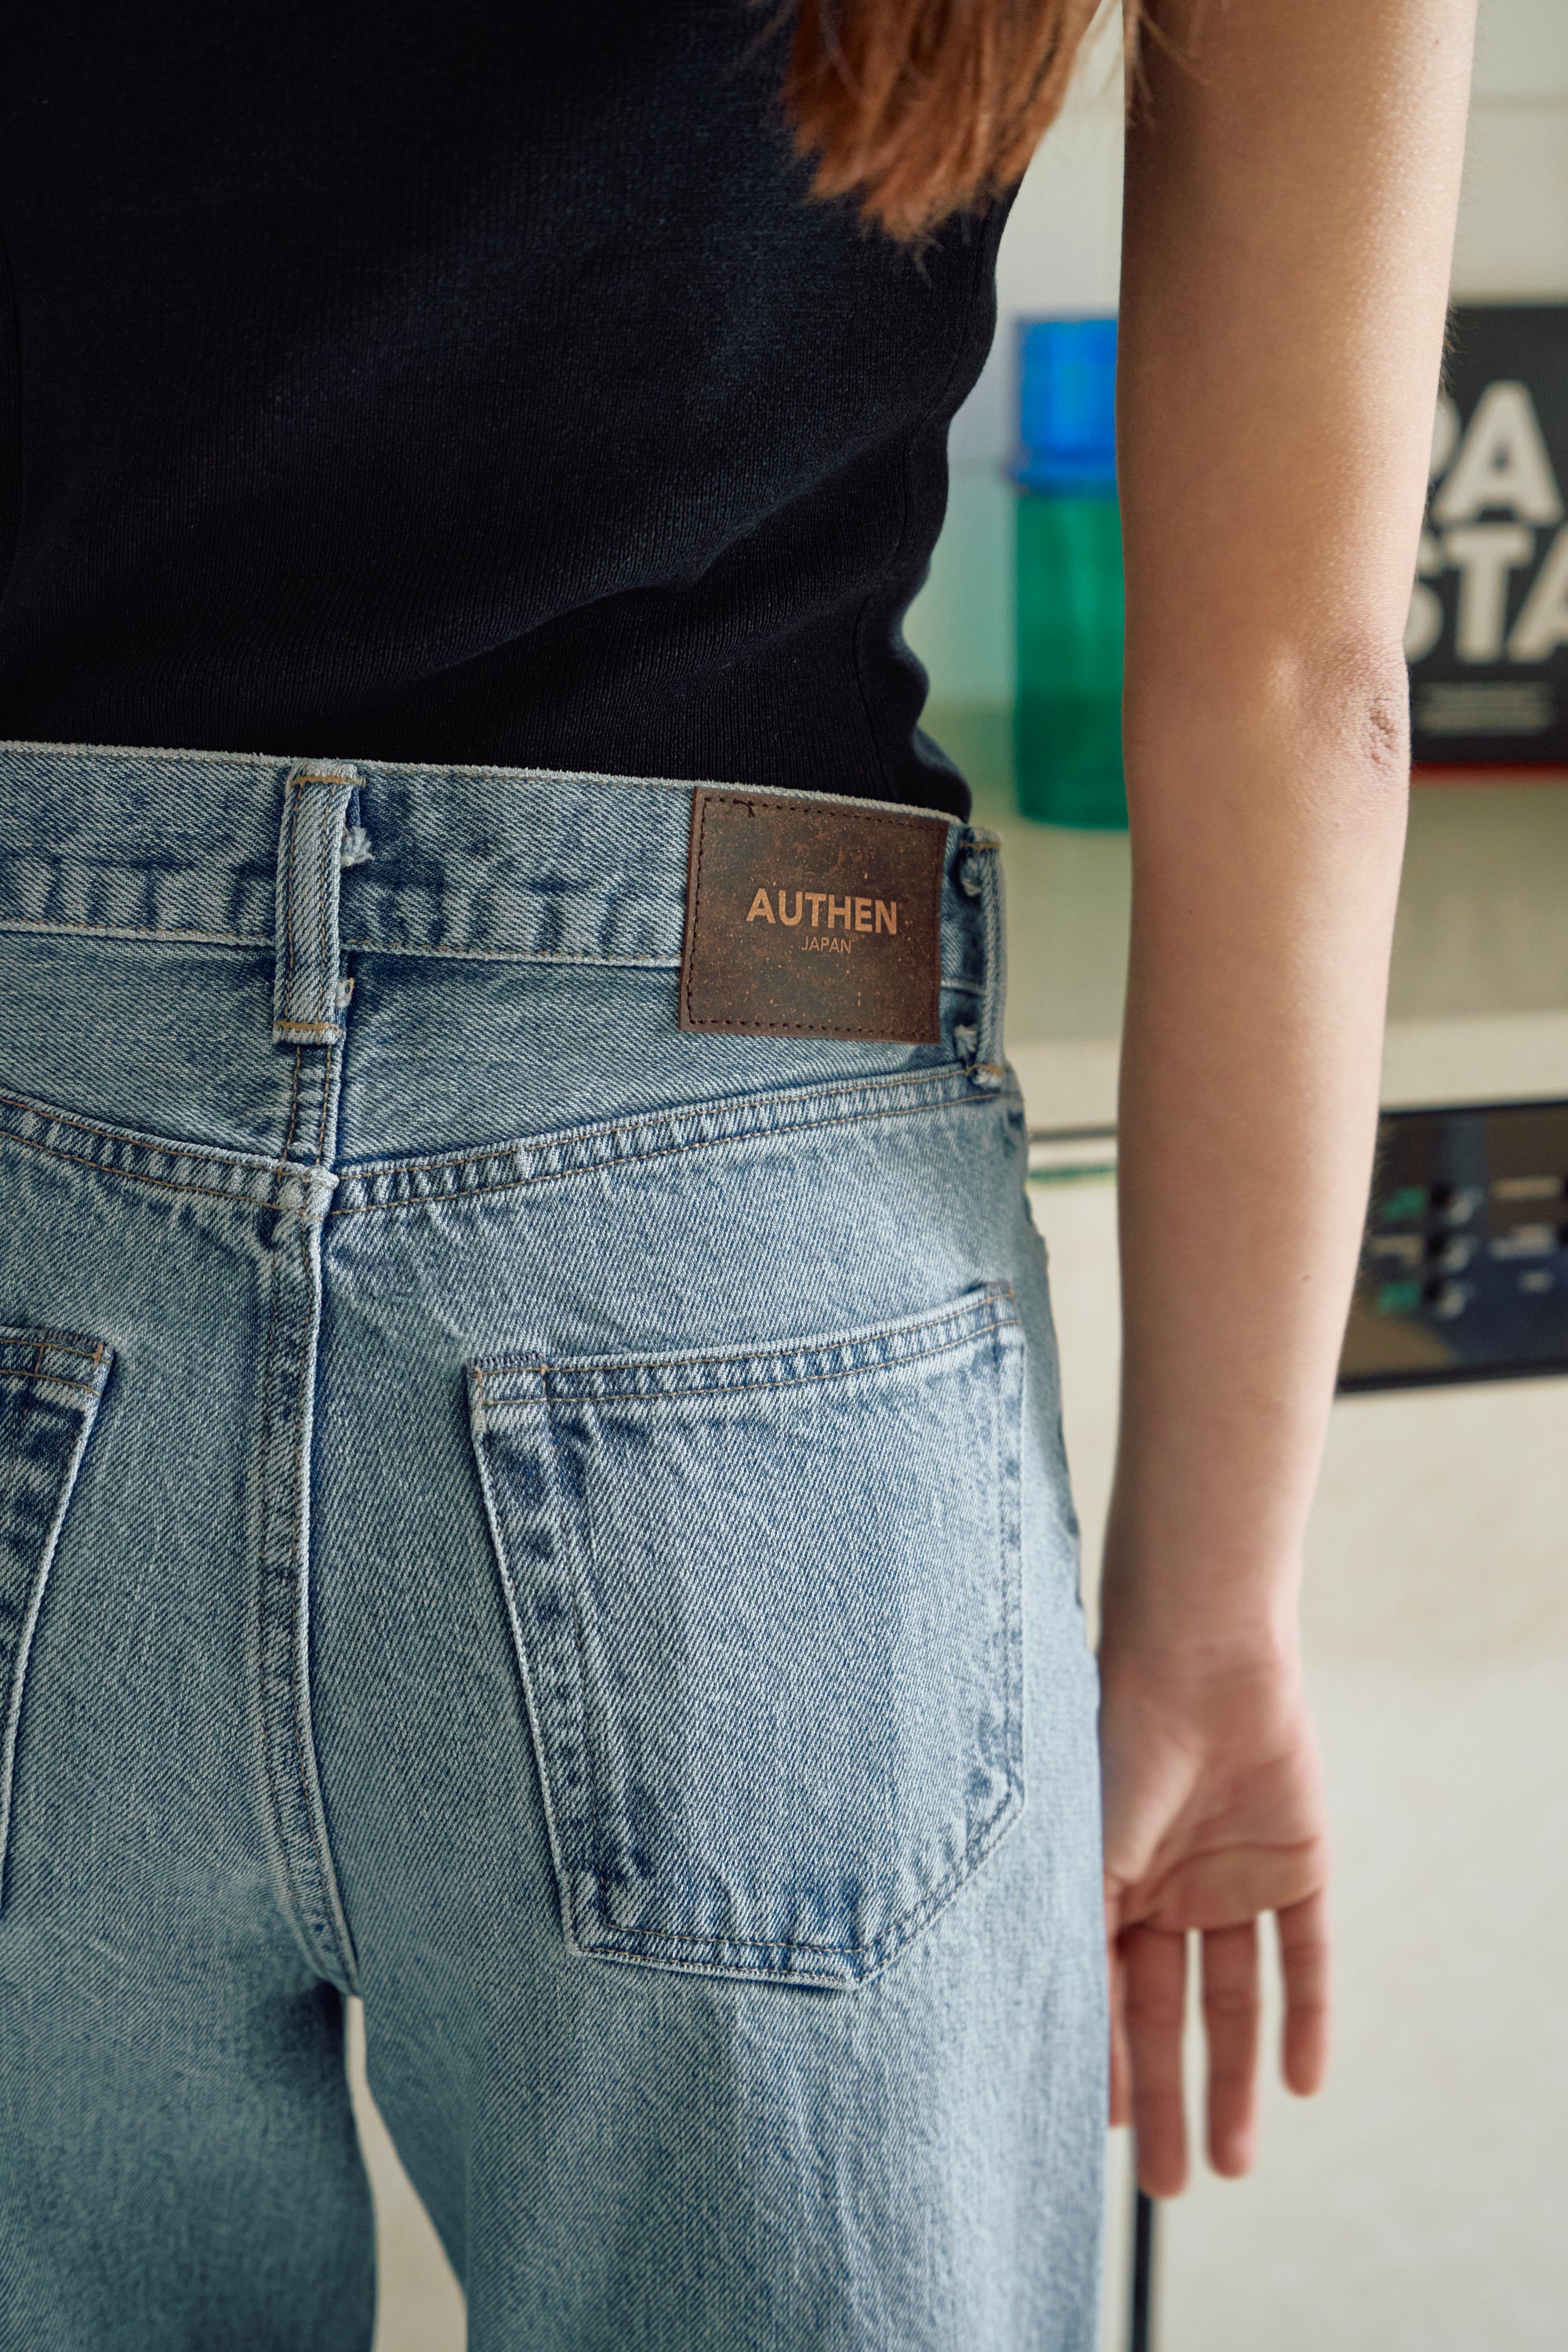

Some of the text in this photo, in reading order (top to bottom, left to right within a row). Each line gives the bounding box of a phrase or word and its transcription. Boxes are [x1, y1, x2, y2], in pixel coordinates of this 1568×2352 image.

[1429, 379, 1564, 526] A
[746, 887, 898, 935] AUTHEN
[801, 935, 852, 954] JAPAN
